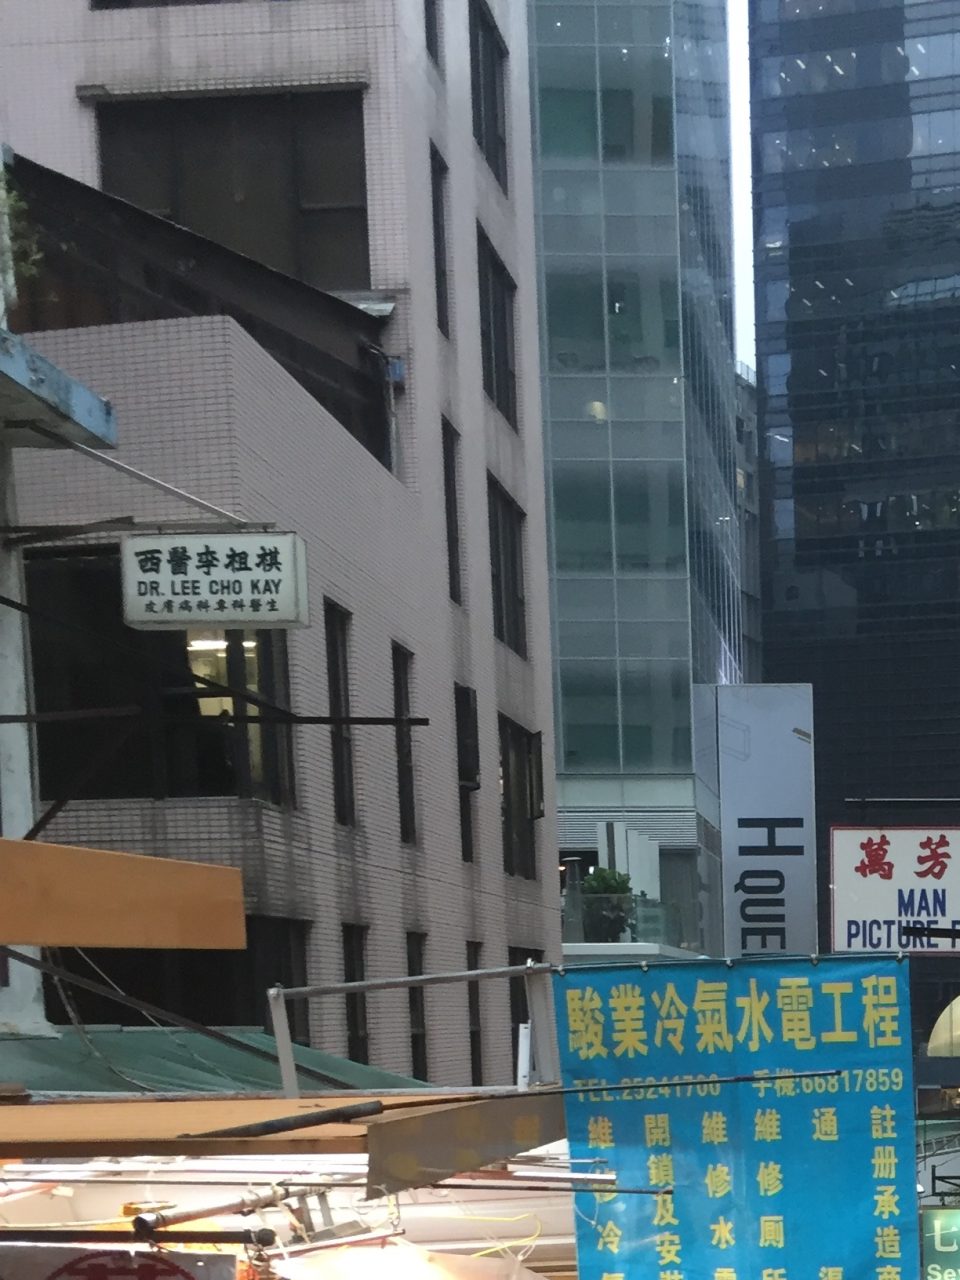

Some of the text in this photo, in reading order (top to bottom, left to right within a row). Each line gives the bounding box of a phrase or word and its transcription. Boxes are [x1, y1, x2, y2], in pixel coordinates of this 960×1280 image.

[137, 578, 283, 597] DR. LEE CHO KAY
[737, 817, 805, 856] H
[897, 888, 947, 919] MAN
[847, 919, 939, 949] PICTURE
[564, 974, 902, 1060] 駿業冷氣水電工程
